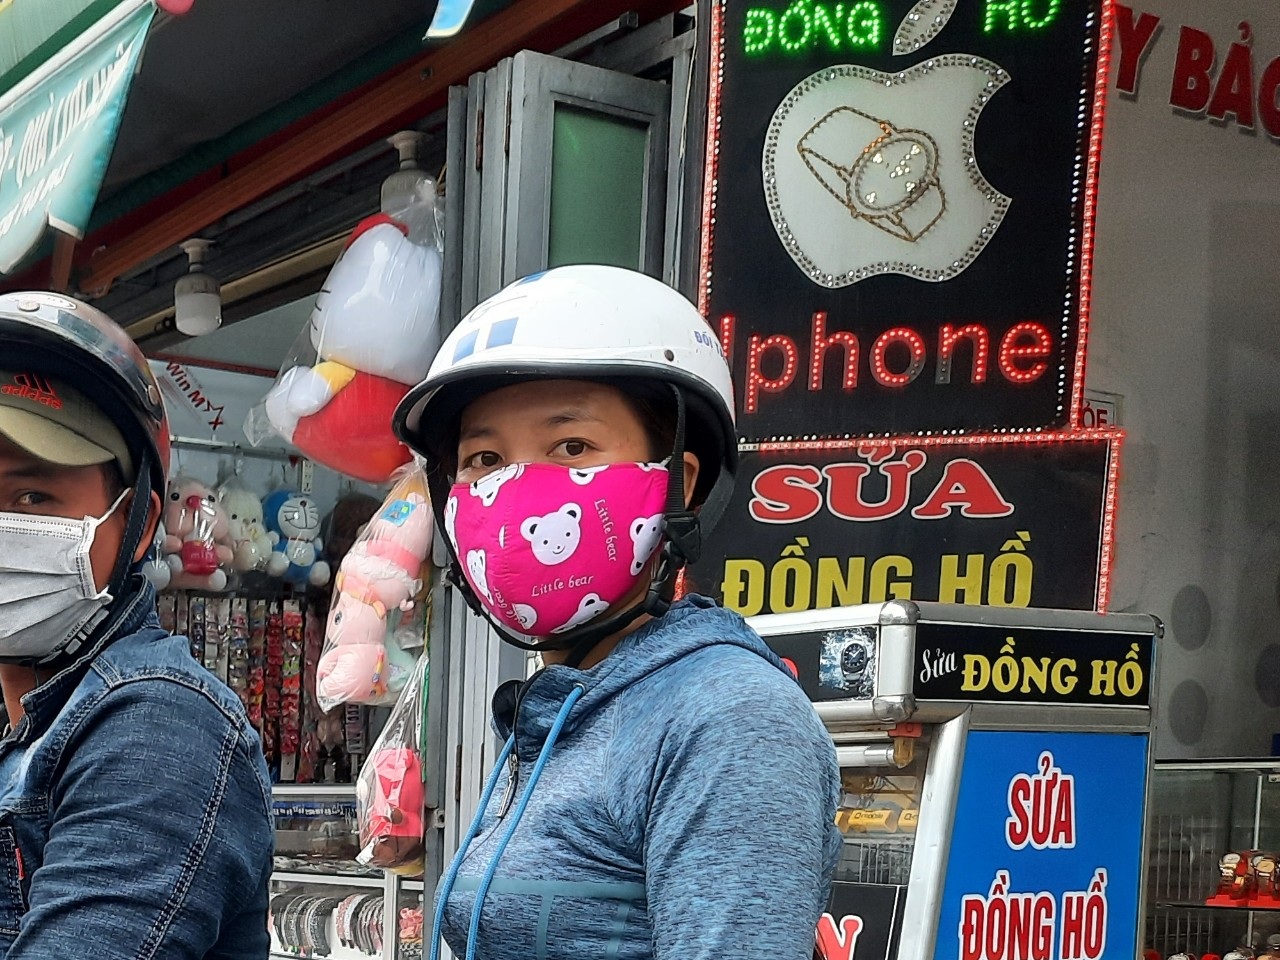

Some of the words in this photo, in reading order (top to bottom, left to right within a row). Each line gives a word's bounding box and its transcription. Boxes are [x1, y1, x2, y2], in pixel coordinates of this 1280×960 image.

[16, 92, 55, 189] QUÀ
[166, 361, 191, 392] Win
[720, 312, 1053, 413] Iphone
[0, 383, 64, 410] adidas
[1082, 401, 1108, 428] ỎE
[749, 441, 1015, 524] SỬA
[594, 498, 613, 534] Little
[605, 532, 617, 562] bear
[531, 577, 564, 597] Little
[568, 574, 595, 590] bear
[721, 537, 914, 616] ĐỒNG
[938, 531, 1035, 609] HỒ
[920, 647, 958, 683] Sửa
[961, 637, 1080, 693] ĐỒNG
[1088, 643, 1144, 697] HỒ
[1006, 751, 1075, 849] SỬA
